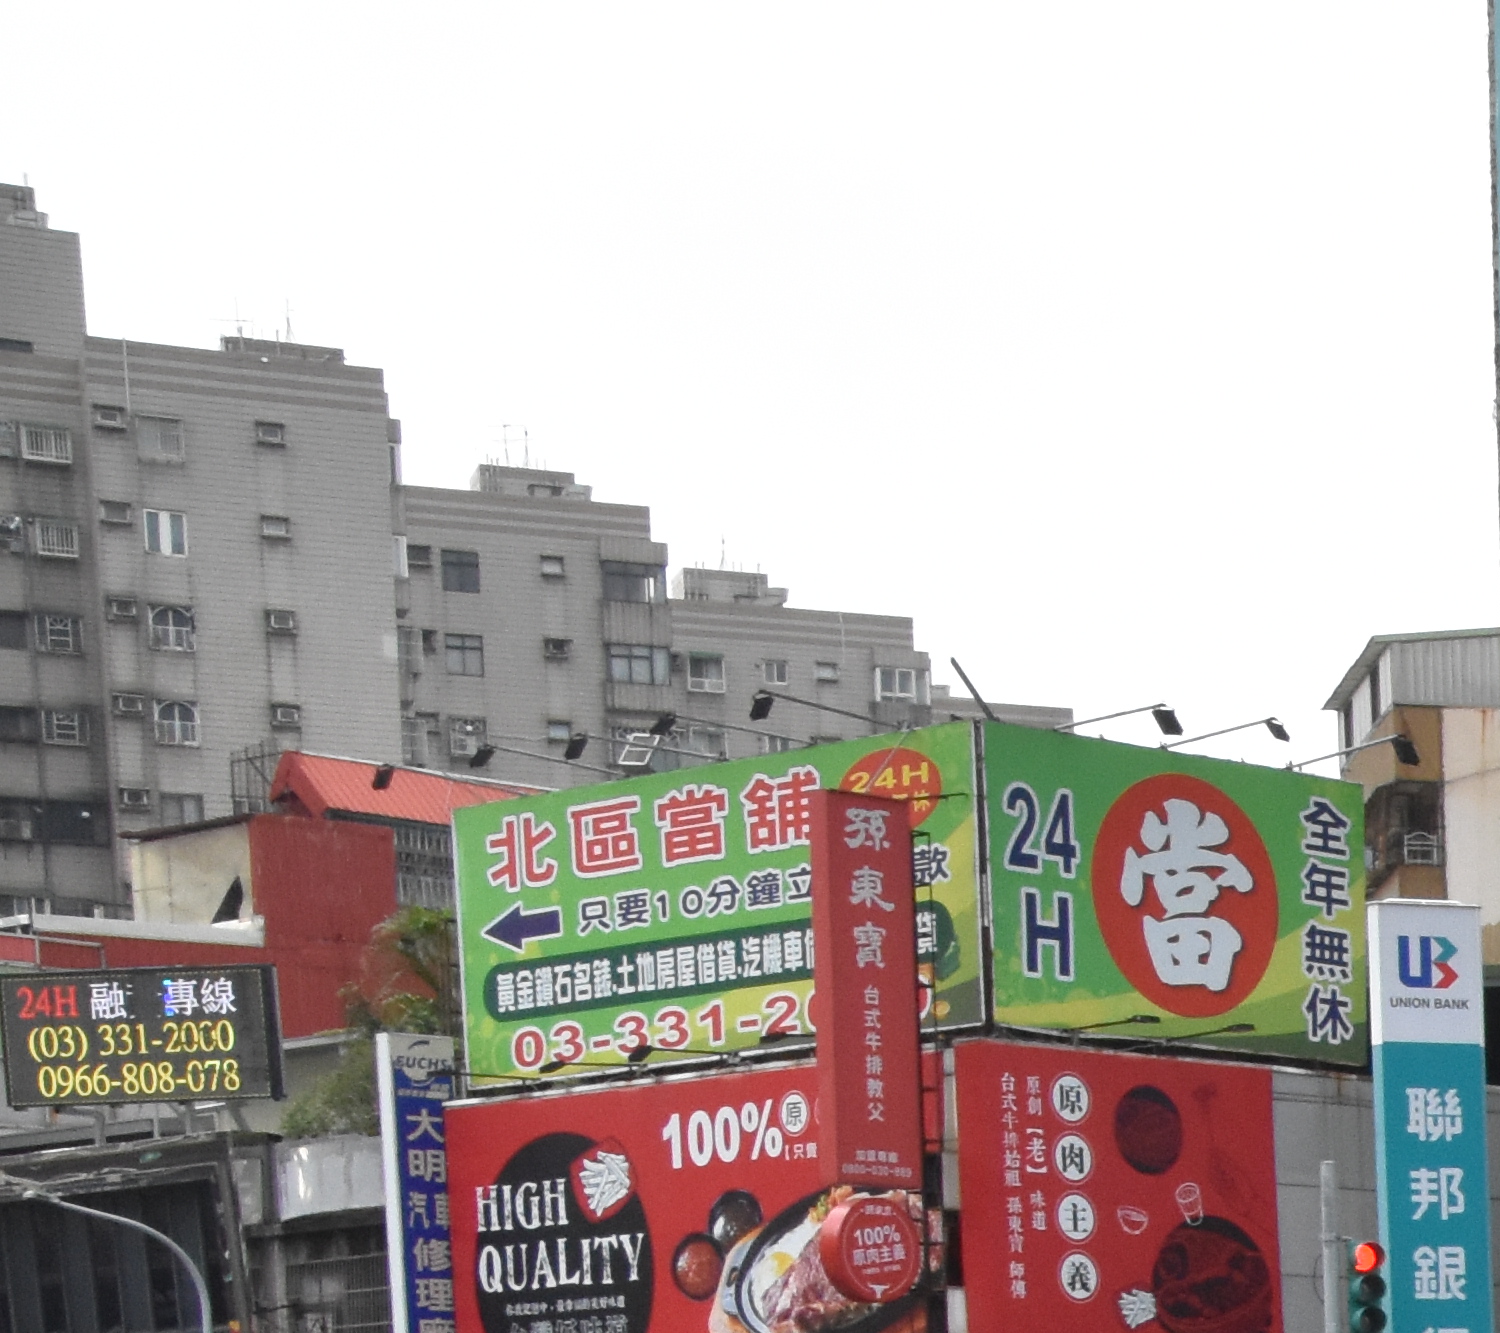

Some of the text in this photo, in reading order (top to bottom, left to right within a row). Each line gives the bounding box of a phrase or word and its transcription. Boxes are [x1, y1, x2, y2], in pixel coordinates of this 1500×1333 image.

[486, 765, 822, 893] 北區當舖
[1003, 781, 1080, 879] 24
[1120, 798, 1254, 991] 當
[1300, 796, 1353, 1044] 全年無休
[1021, 886, 1076, 982] H
[17, 984, 80, 1020] 24H
[1390, 997, 1469, 1010] UNION BANK
[28, 1019, 235, 1062] (03) 331-2000
[38, 1059, 241, 1098] 0966-808-078
[662, 1099, 784, 1170] 100%
[475, 1178, 570, 1233] HIGH
[1058, 1083, 1093, 1294] 原肉主義
[478, 1232, 645, 1293] QUALITY
[853, 1224, 901, 1247] 100%
